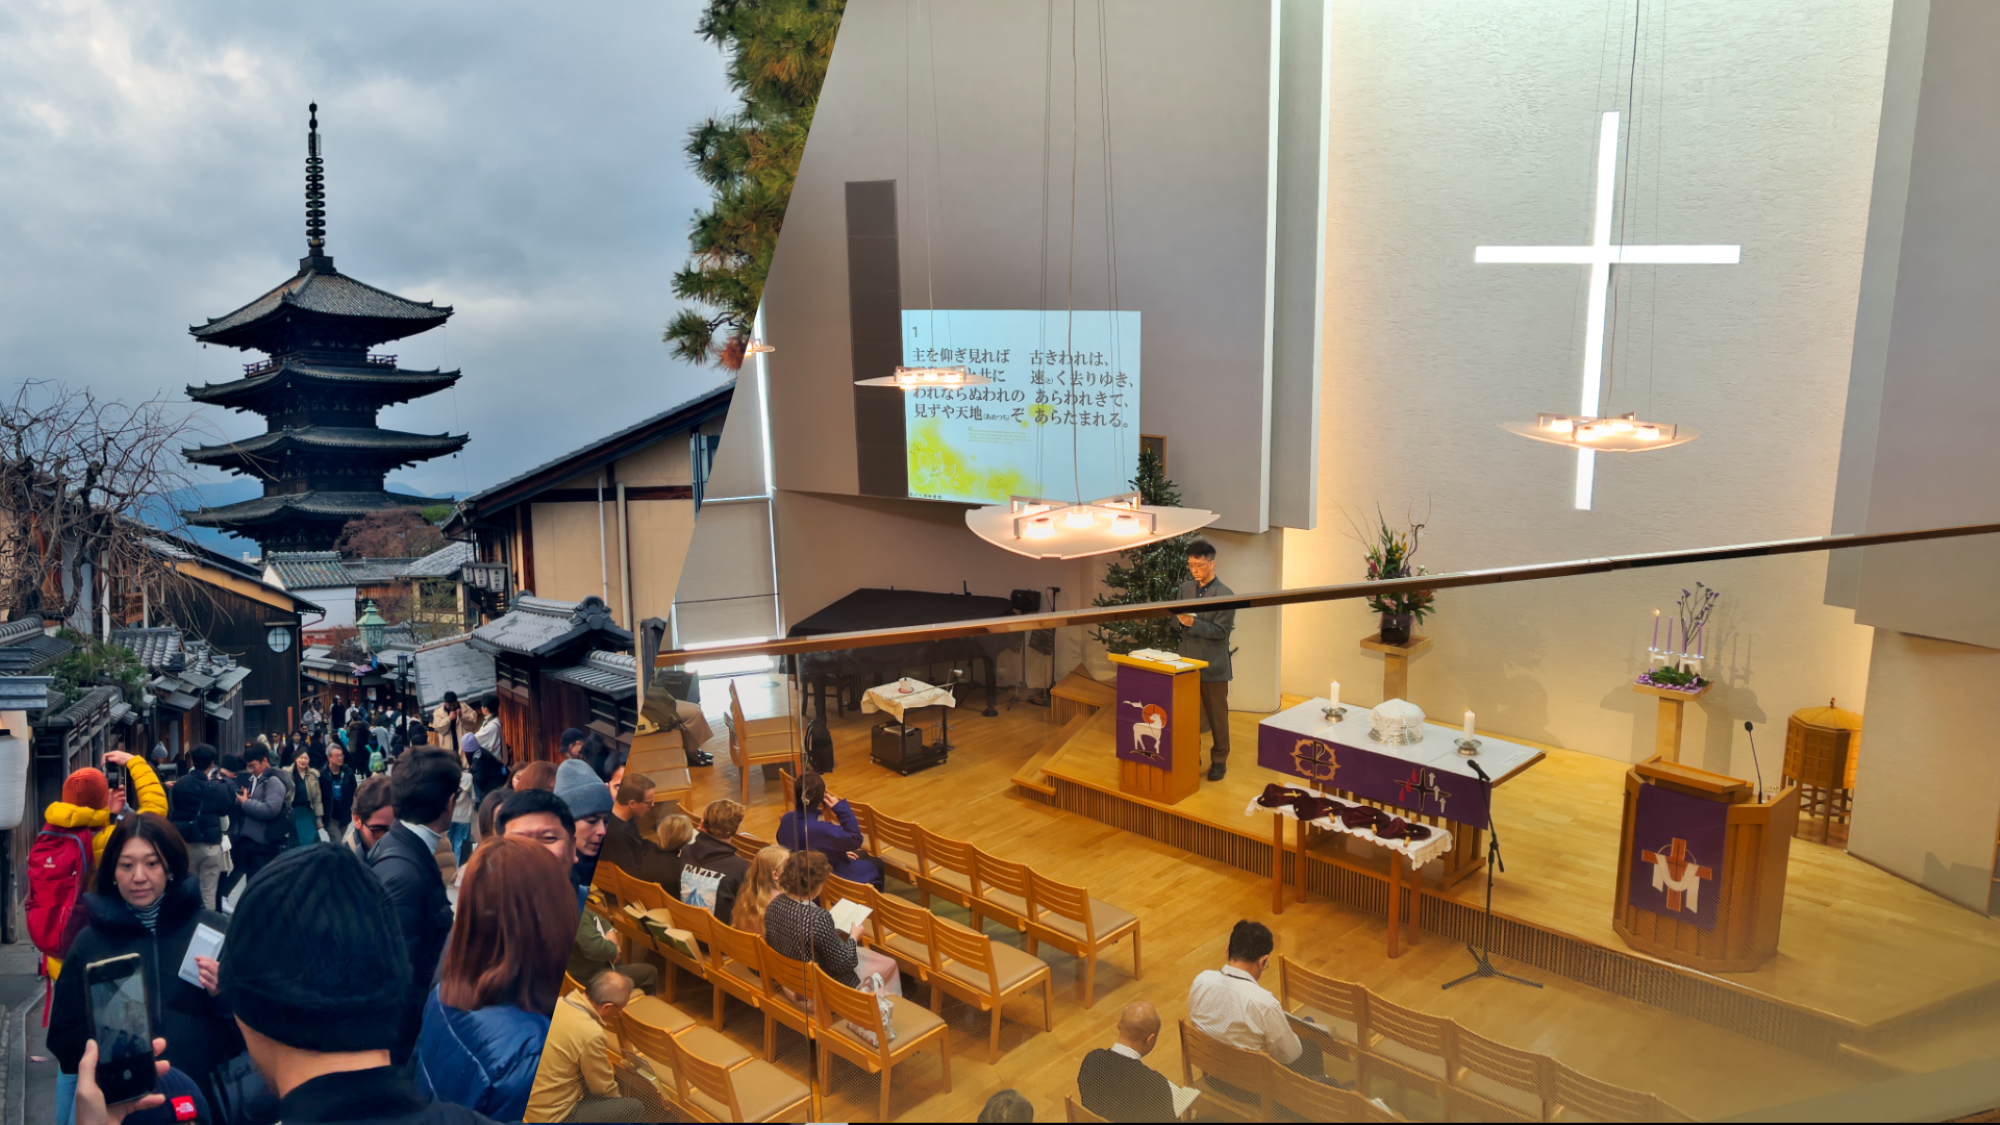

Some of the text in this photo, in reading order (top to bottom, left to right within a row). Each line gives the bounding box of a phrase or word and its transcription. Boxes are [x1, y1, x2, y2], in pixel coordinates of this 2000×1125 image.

[911, 326, 919, 338] 1
[912, 347, 1010, 364] 主を仰ぎ見れば
[1029, 349, 1109, 366] 古きわれは、
[913, 386, 1025, 403] われならぬわれの
[1035, 388, 1129, 408] あらわれきて、
[1034, 408, 1129, 428] あらたまれる。
